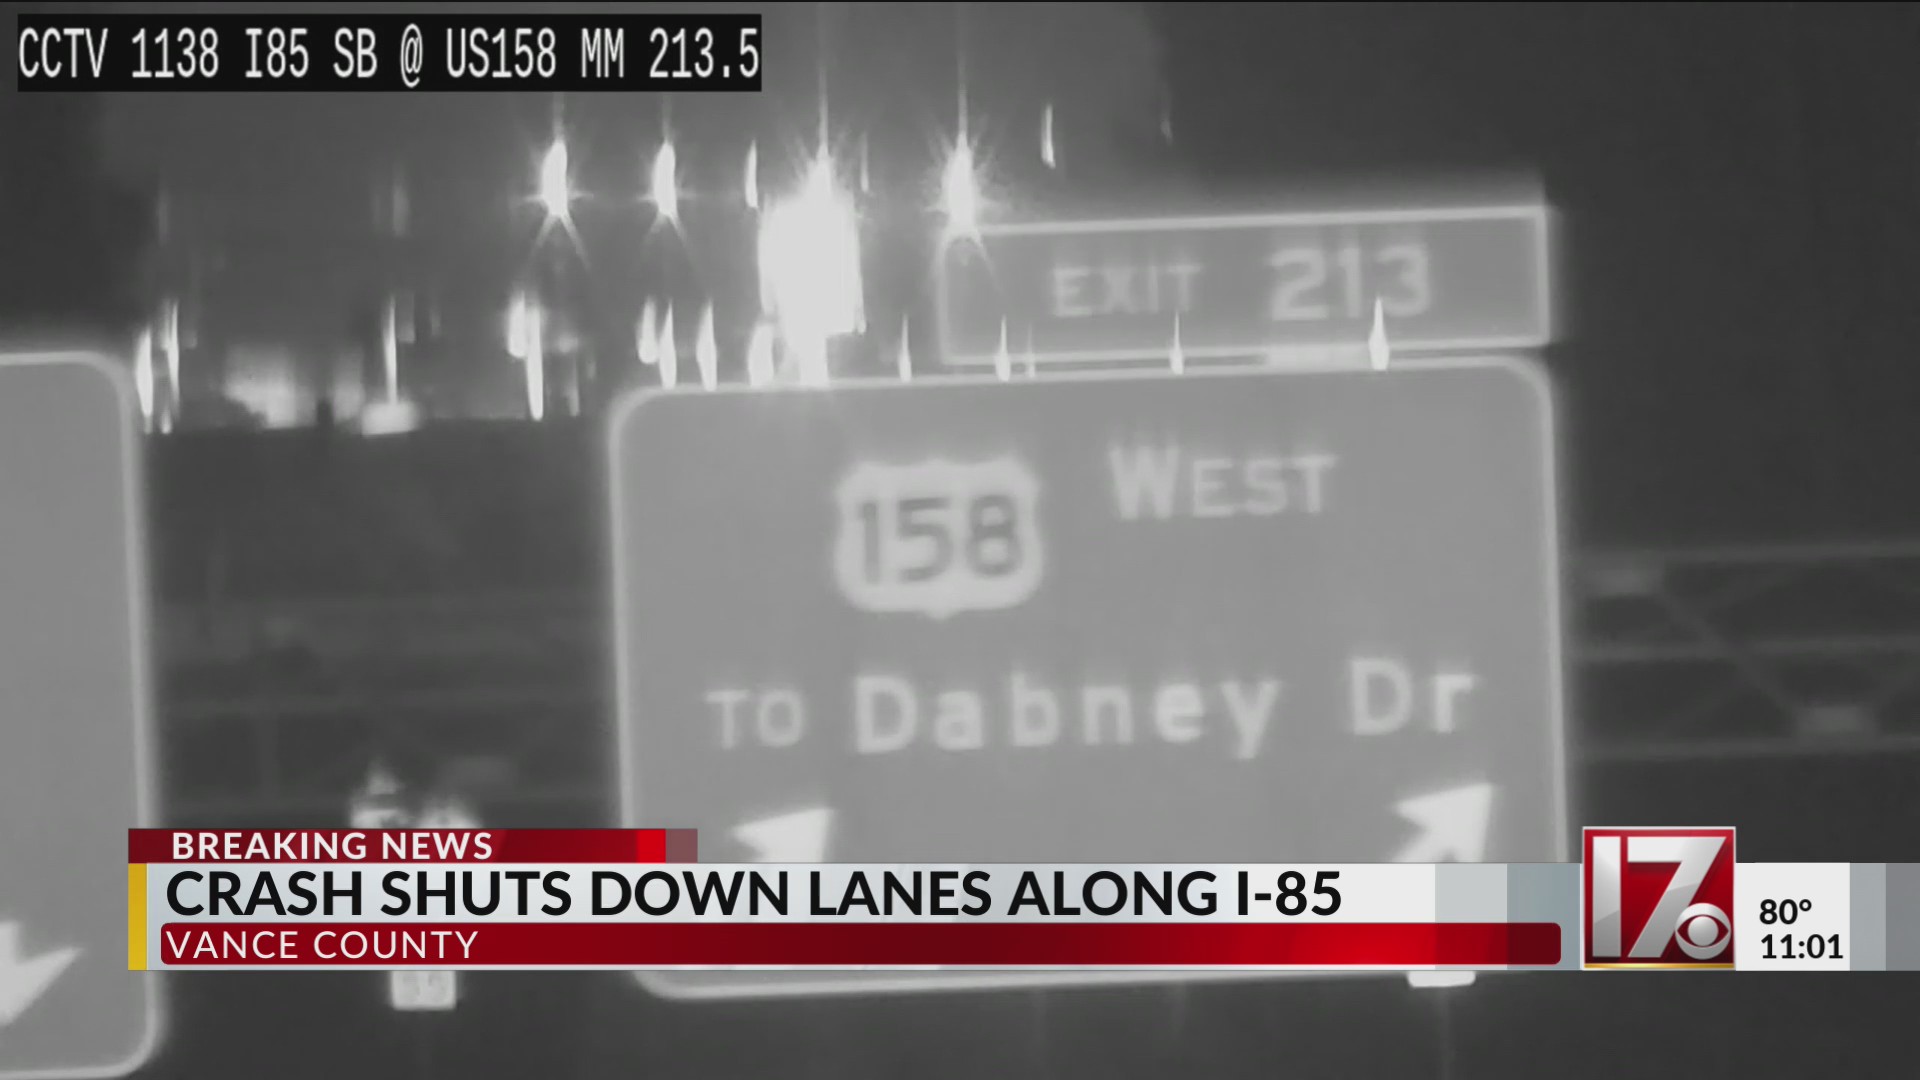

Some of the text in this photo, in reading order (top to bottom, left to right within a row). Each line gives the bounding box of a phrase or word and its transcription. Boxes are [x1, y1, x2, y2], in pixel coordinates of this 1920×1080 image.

[1053, 245, 1430, 321] EXIT 213
[1109, 445, 1337, 520] WEST
[857, 495, 1023, 585] 158
[708, 658, 1477, 760] TO Dabney Dr
